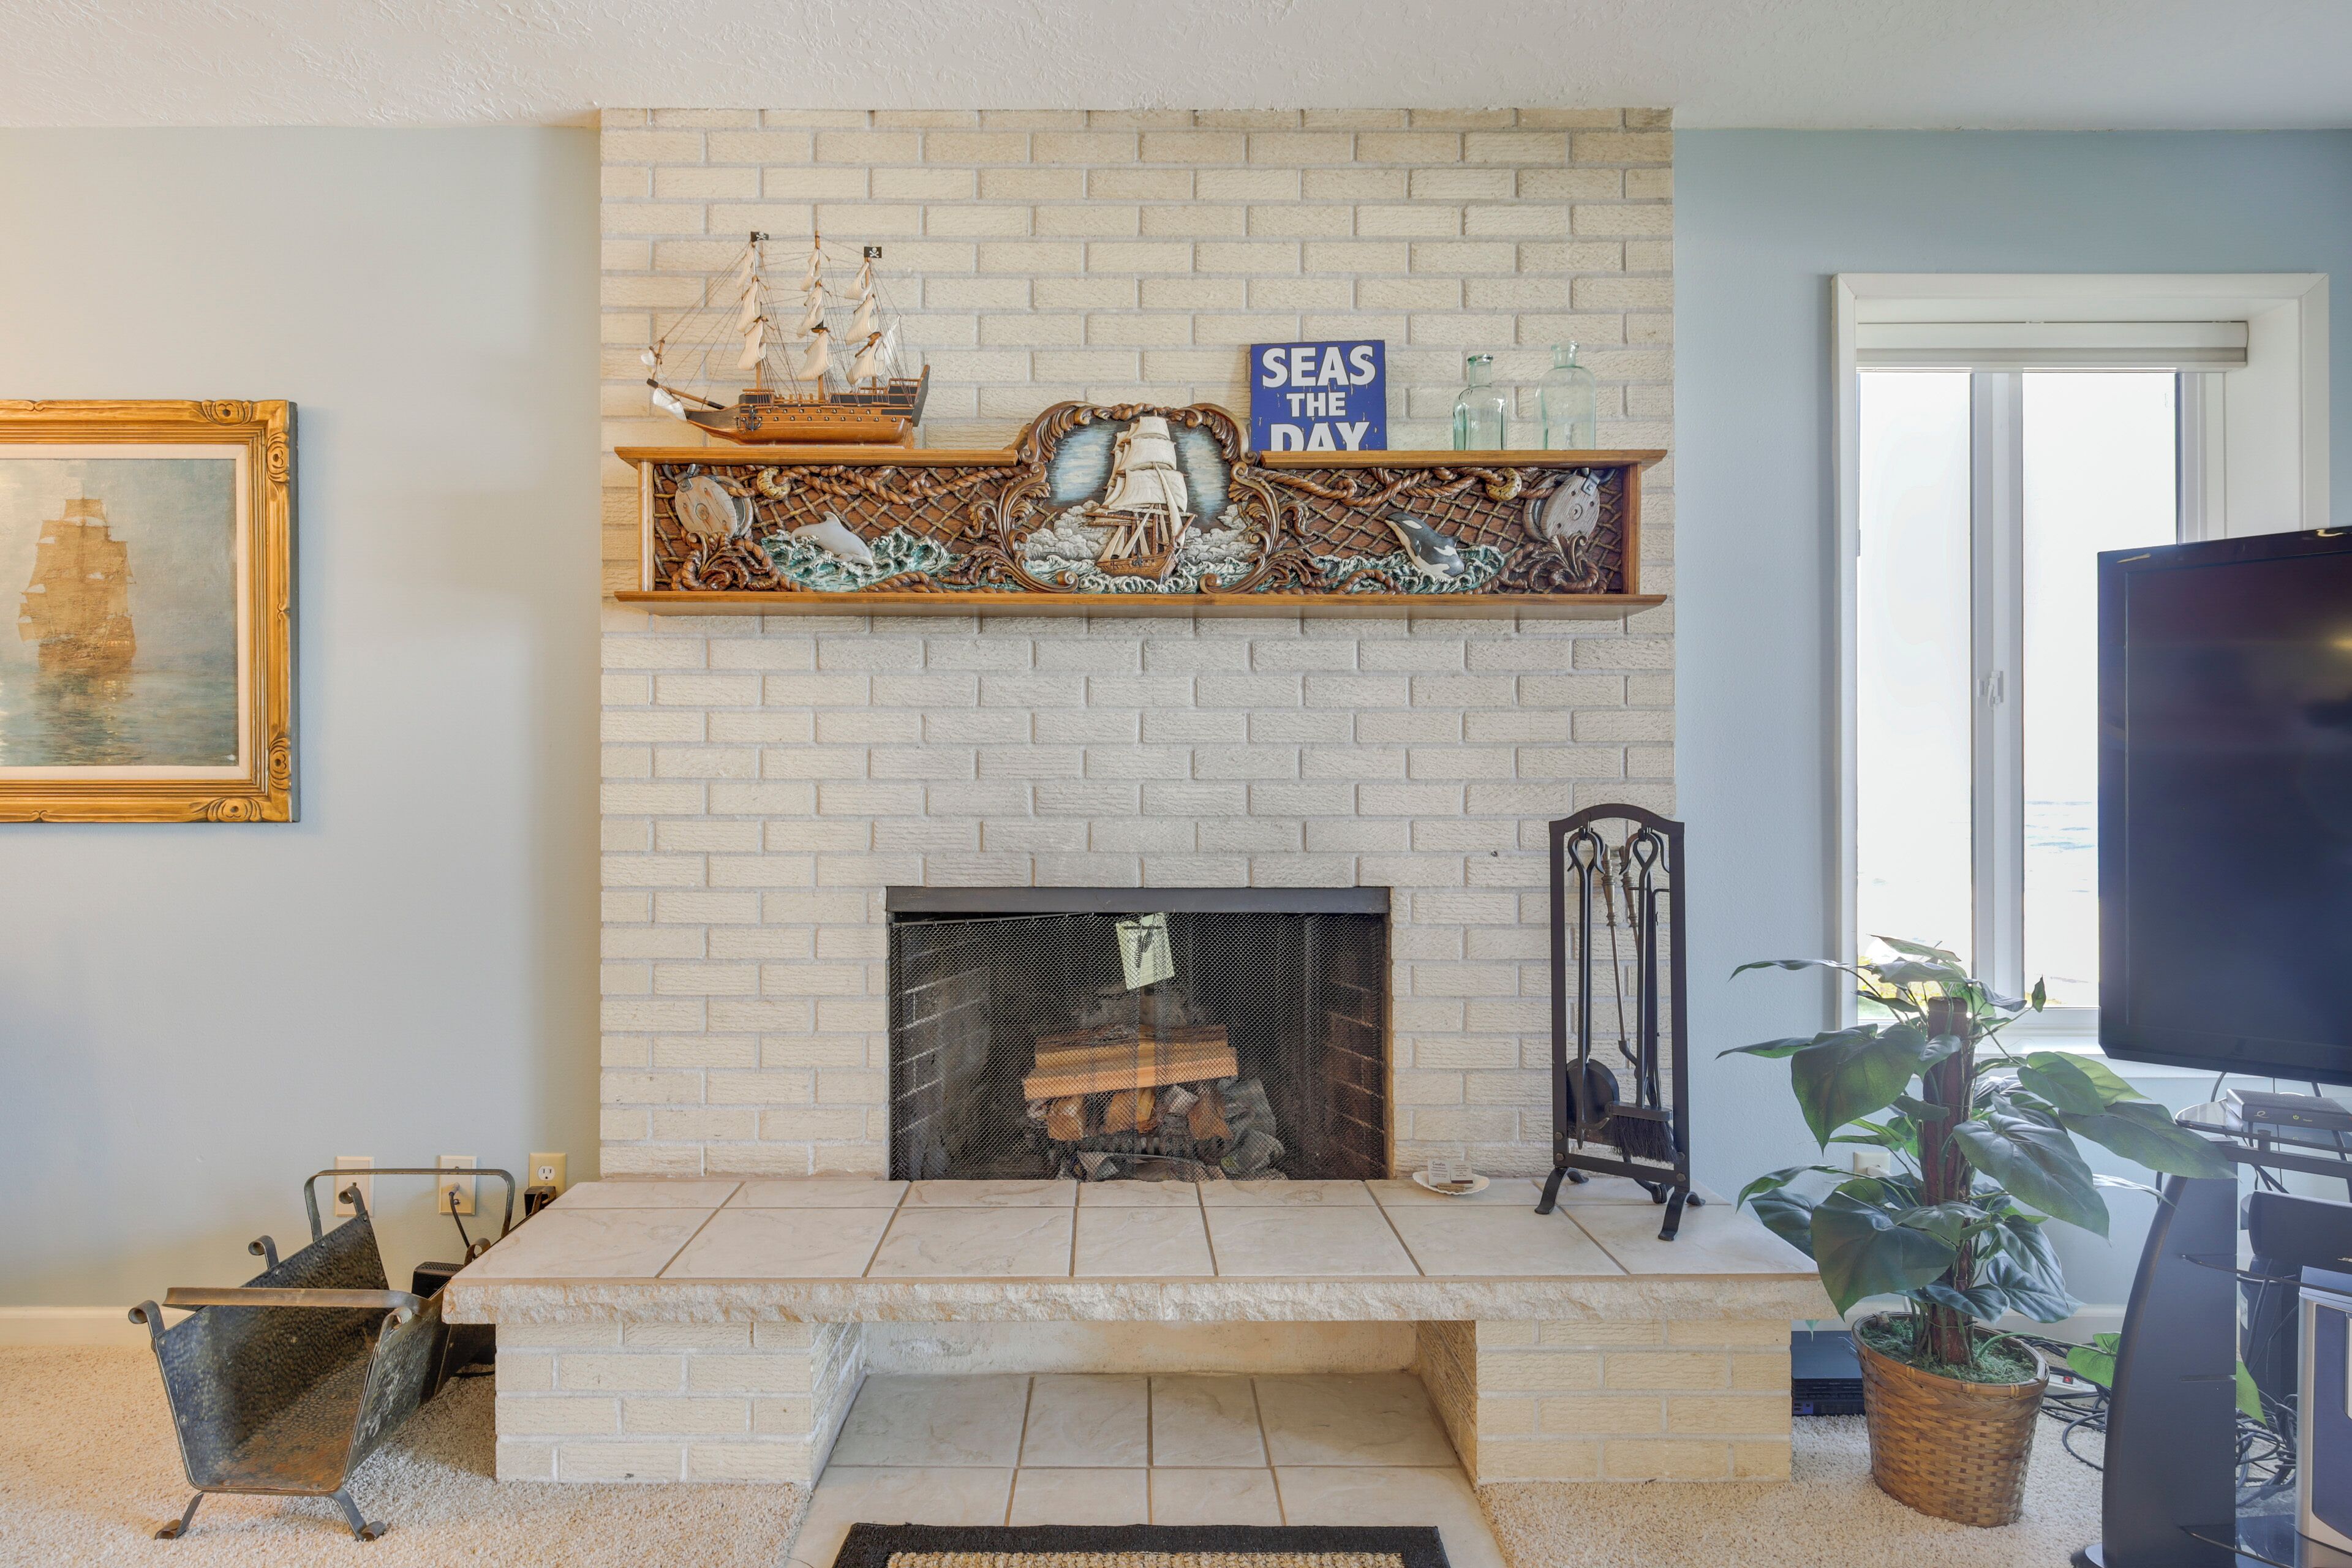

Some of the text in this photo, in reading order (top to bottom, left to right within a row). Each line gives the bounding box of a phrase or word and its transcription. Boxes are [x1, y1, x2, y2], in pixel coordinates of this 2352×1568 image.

[1262, 345, 1376, 388] SEAS
[1286, 392, 1346, 417] THE
[1270, 421, 1370, 451] DAY
